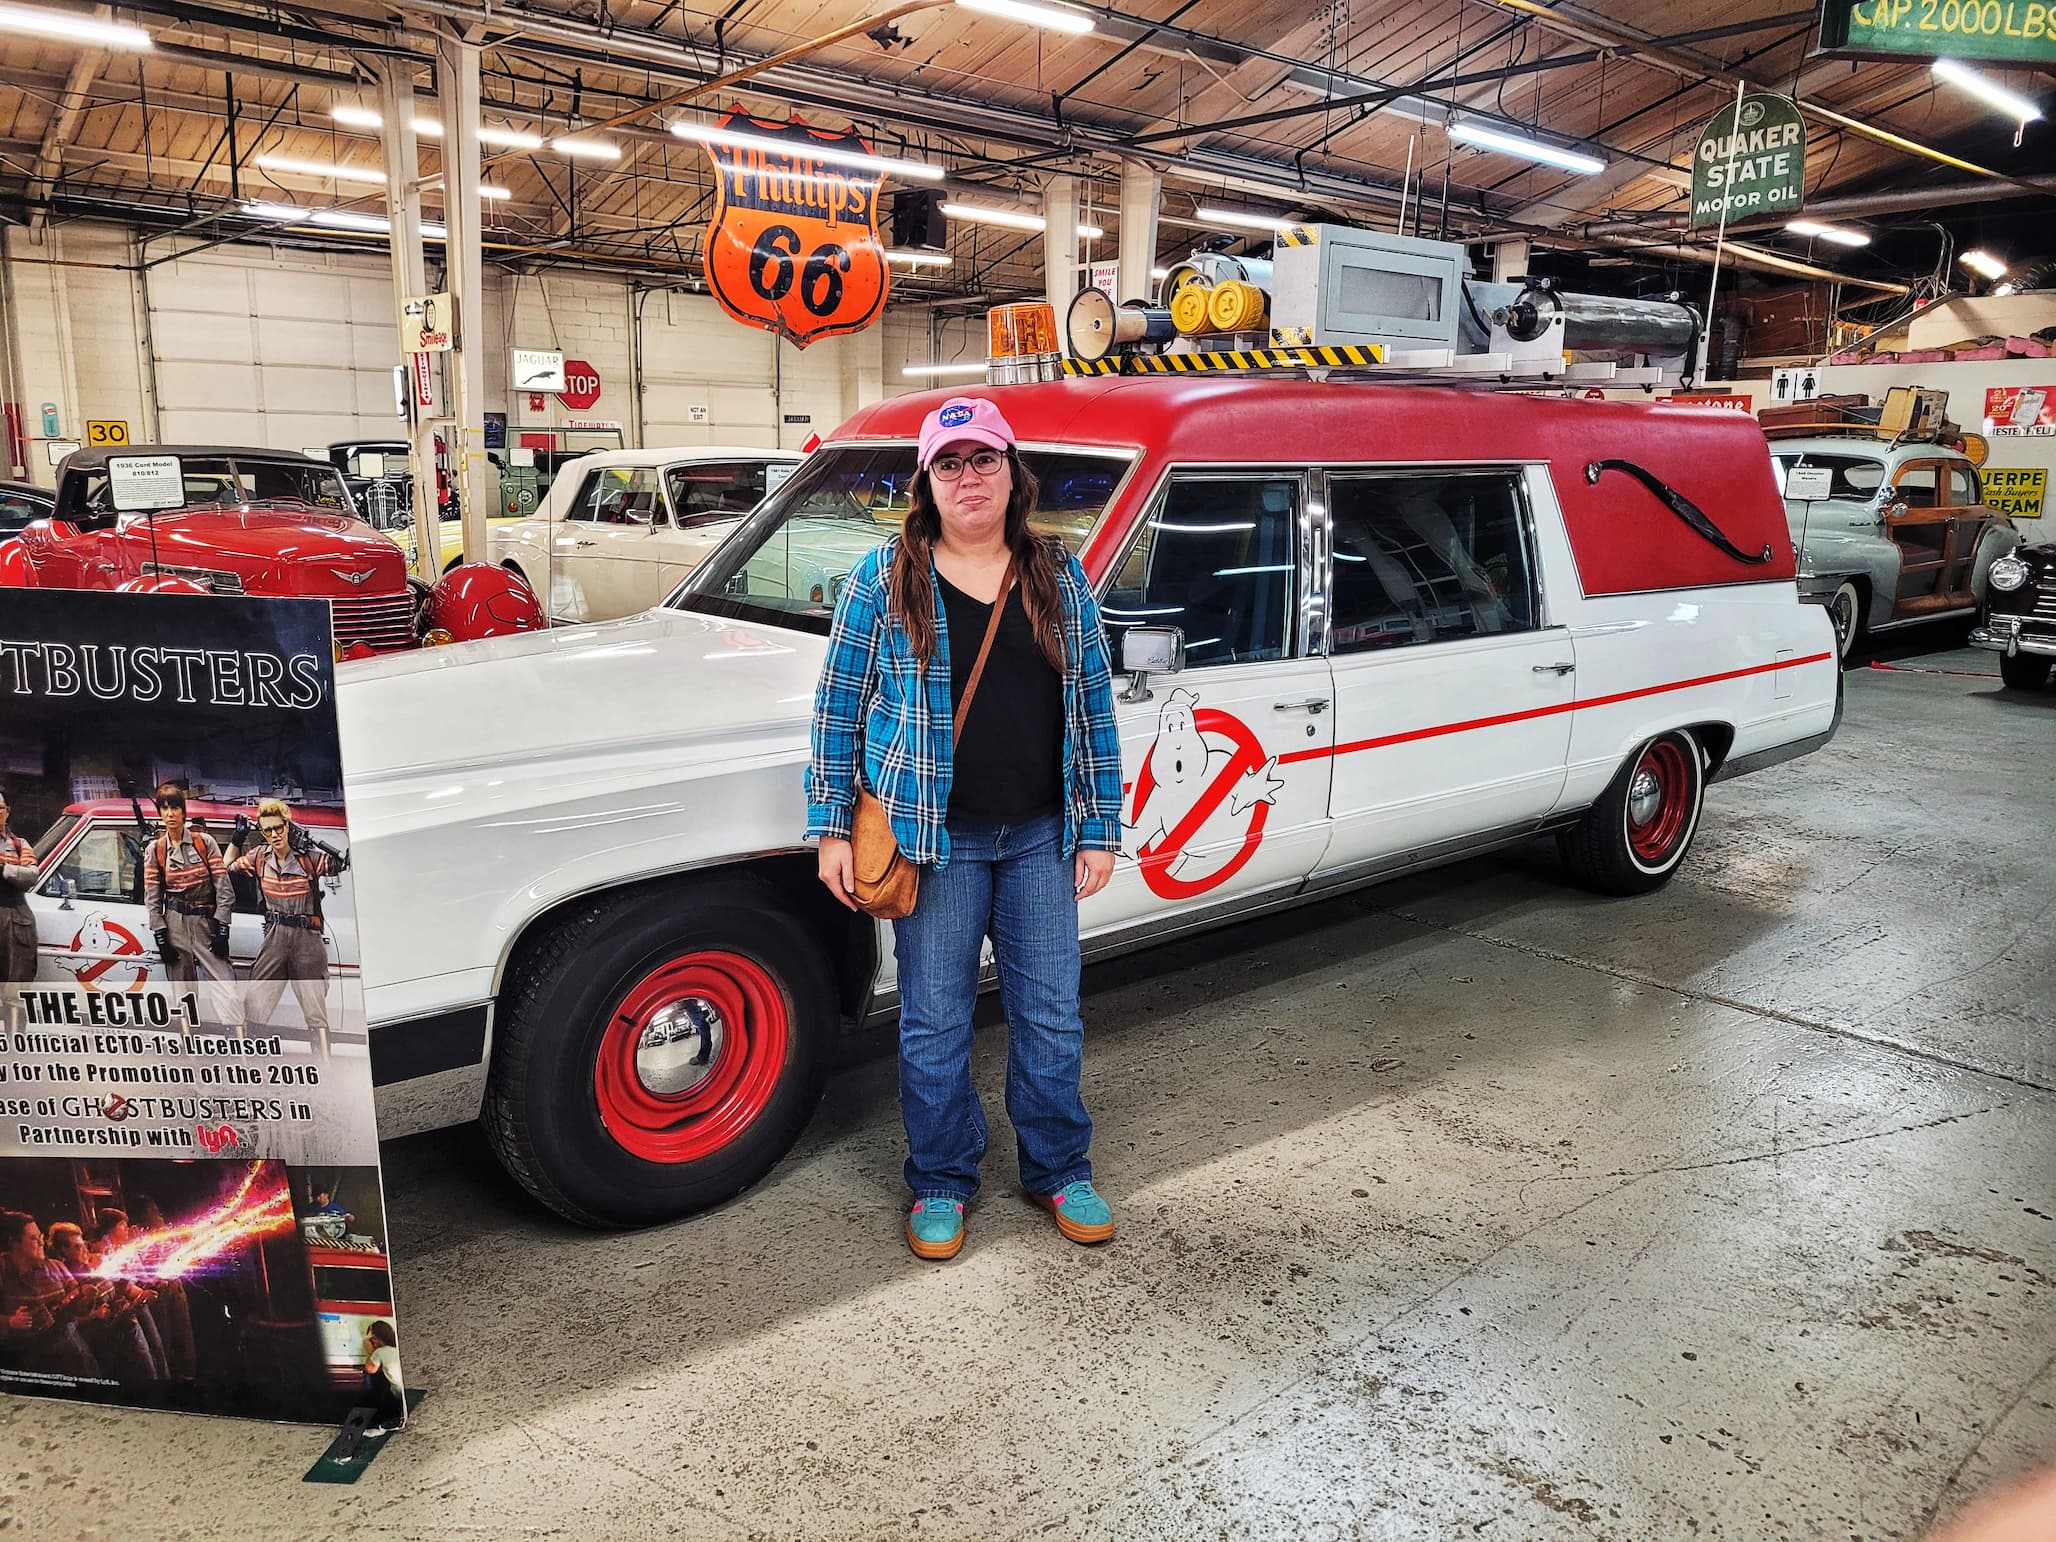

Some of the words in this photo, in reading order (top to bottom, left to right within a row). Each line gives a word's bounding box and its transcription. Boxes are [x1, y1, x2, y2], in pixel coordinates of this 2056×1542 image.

[1699, 122, 1800, 163] QUAKER
[1706, 152, 1790, 187] STATE
[722, 143, 866, 228] Phillips
[1695, 191, 1761, 214] MOTOR
[1767, 185, 1798, 202] OIL
[750, 224, 851, 317] 66
[1094, 268, 1116, 277] SMILE
[1098, 279, 1112, 287] YOU
[516, 353, 560, 367] JAGUAR
[942, 411, 971, 422] NASA
[92, 424, 125, 442] 30
[1982, 472, 2043, 486] JERPE
[2004, 486, 2038, 497] Buyers
[1988, 499, 2040, 512] REAM
[19, 991, 82, 1025] THE
[86, 991, 200, 1026] ECTO-1
[14, 1033, 89, 1054] Official
[94, 1034, 179, 1055] ECTO-1's
[184, 1035, 282, 1056] Licensed
[13, 1062, 42, 1081] for
[48, 1063, 81, 1082] the
[86, 1063, 195, 1084] Promotion
[200, 1065, 222, 1084] of
[226, 1065, 263, 1084] the
[267, 1066, 320, 1085] 2016
[37, 1097, 57, 1116] of
[289, 1101, 312, 1120] in
[19, 1125, 142, 1147] Partnership
[146, 1127, 193, 1146] with
